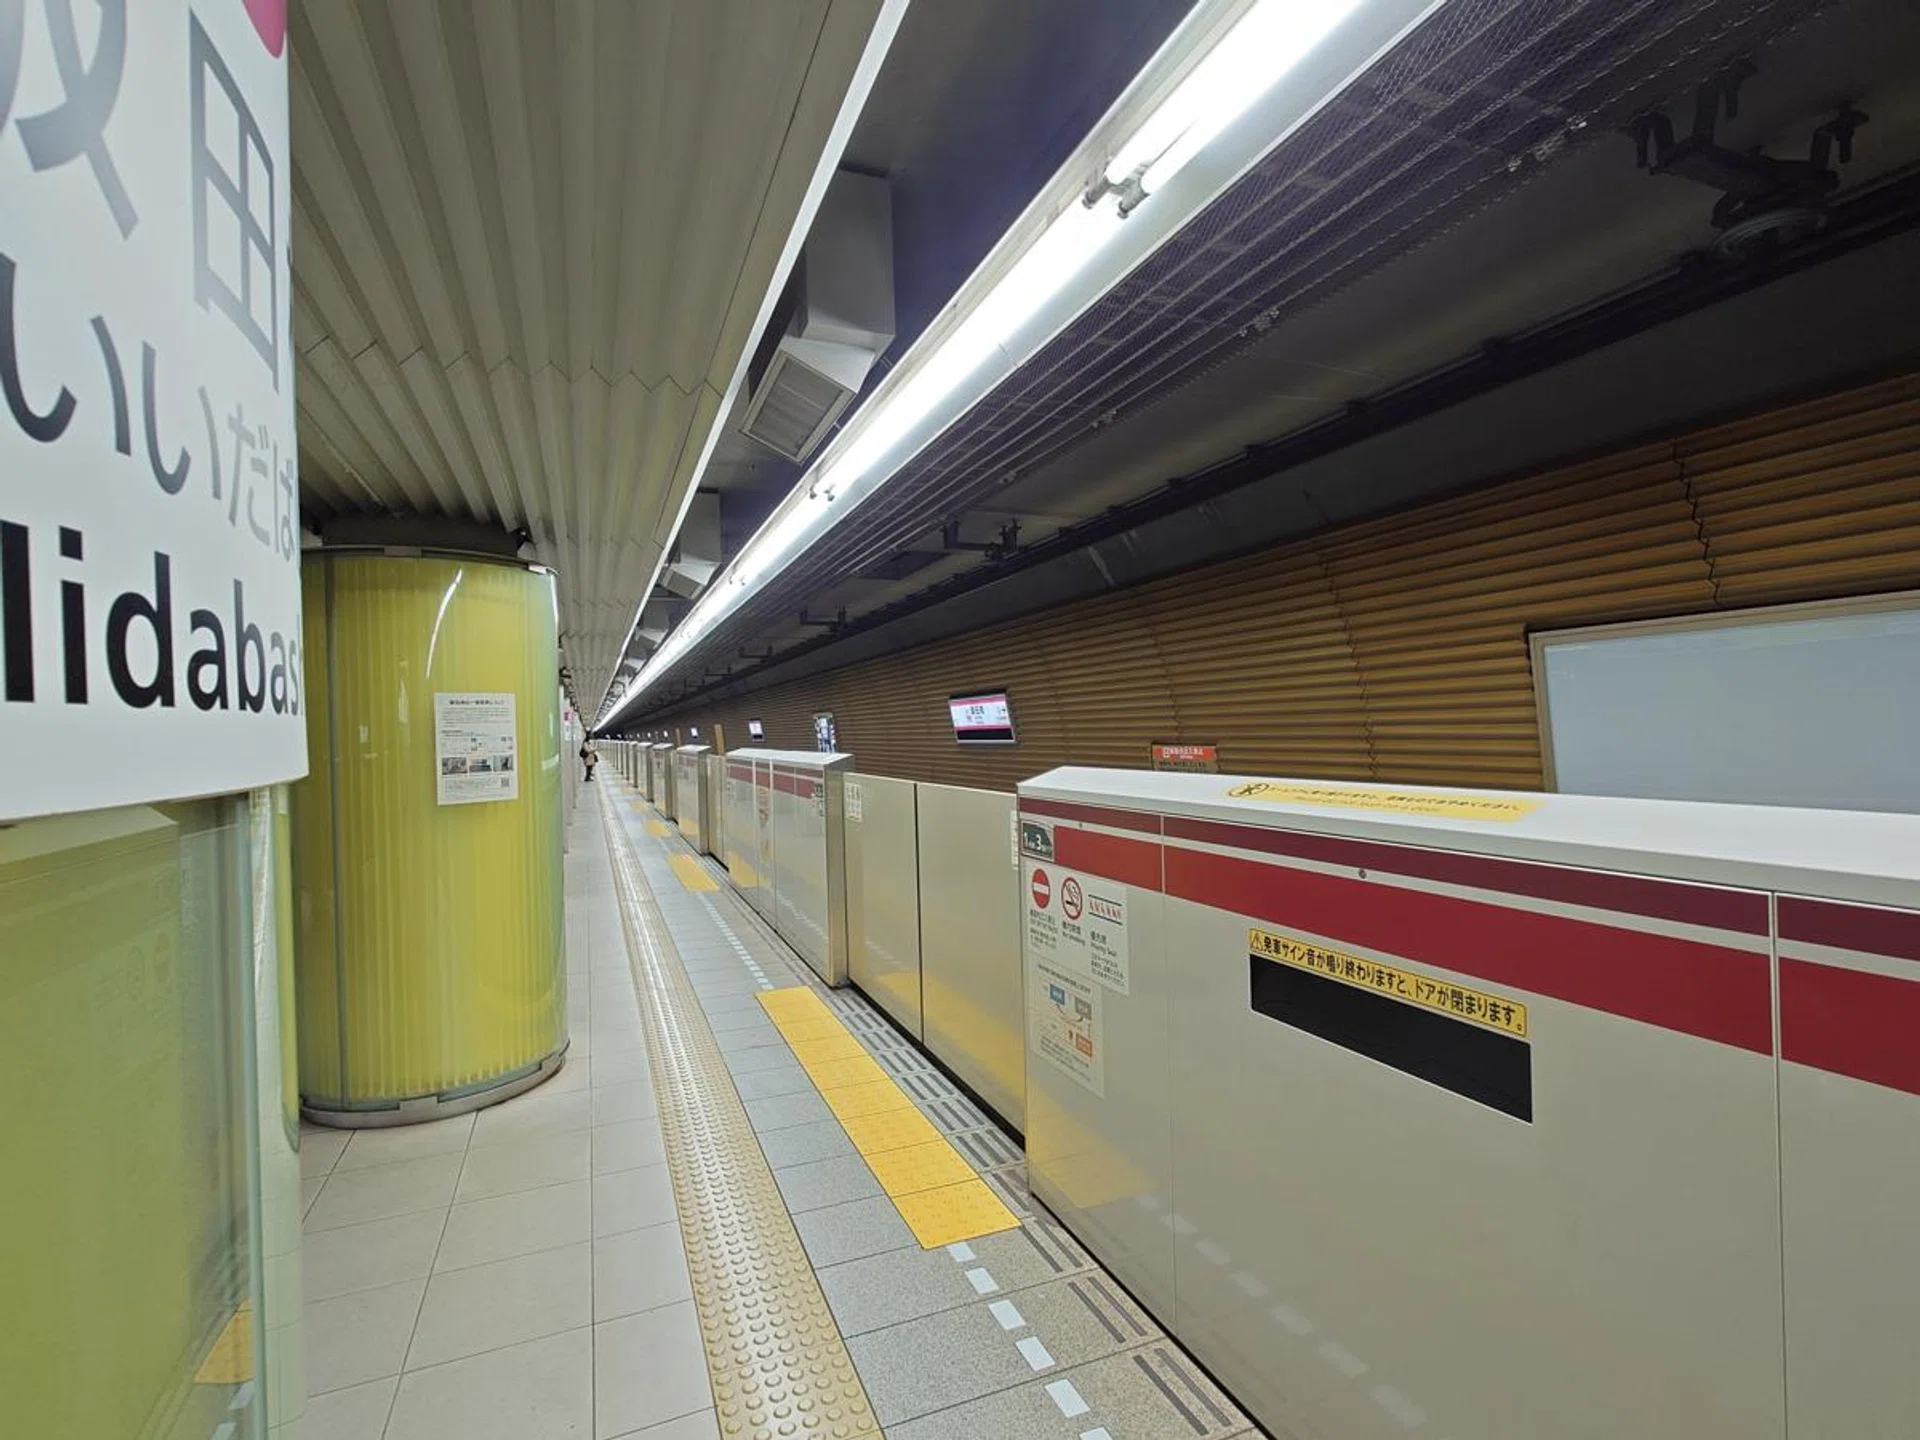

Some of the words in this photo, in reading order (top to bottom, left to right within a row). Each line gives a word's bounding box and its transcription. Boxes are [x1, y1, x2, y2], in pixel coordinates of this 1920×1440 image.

[0, 519, 303, 716] Iidabas
[1263, 935, 1523, 1031] 発車サイン音が鳴り終わりますと、ドアが閉まります。
